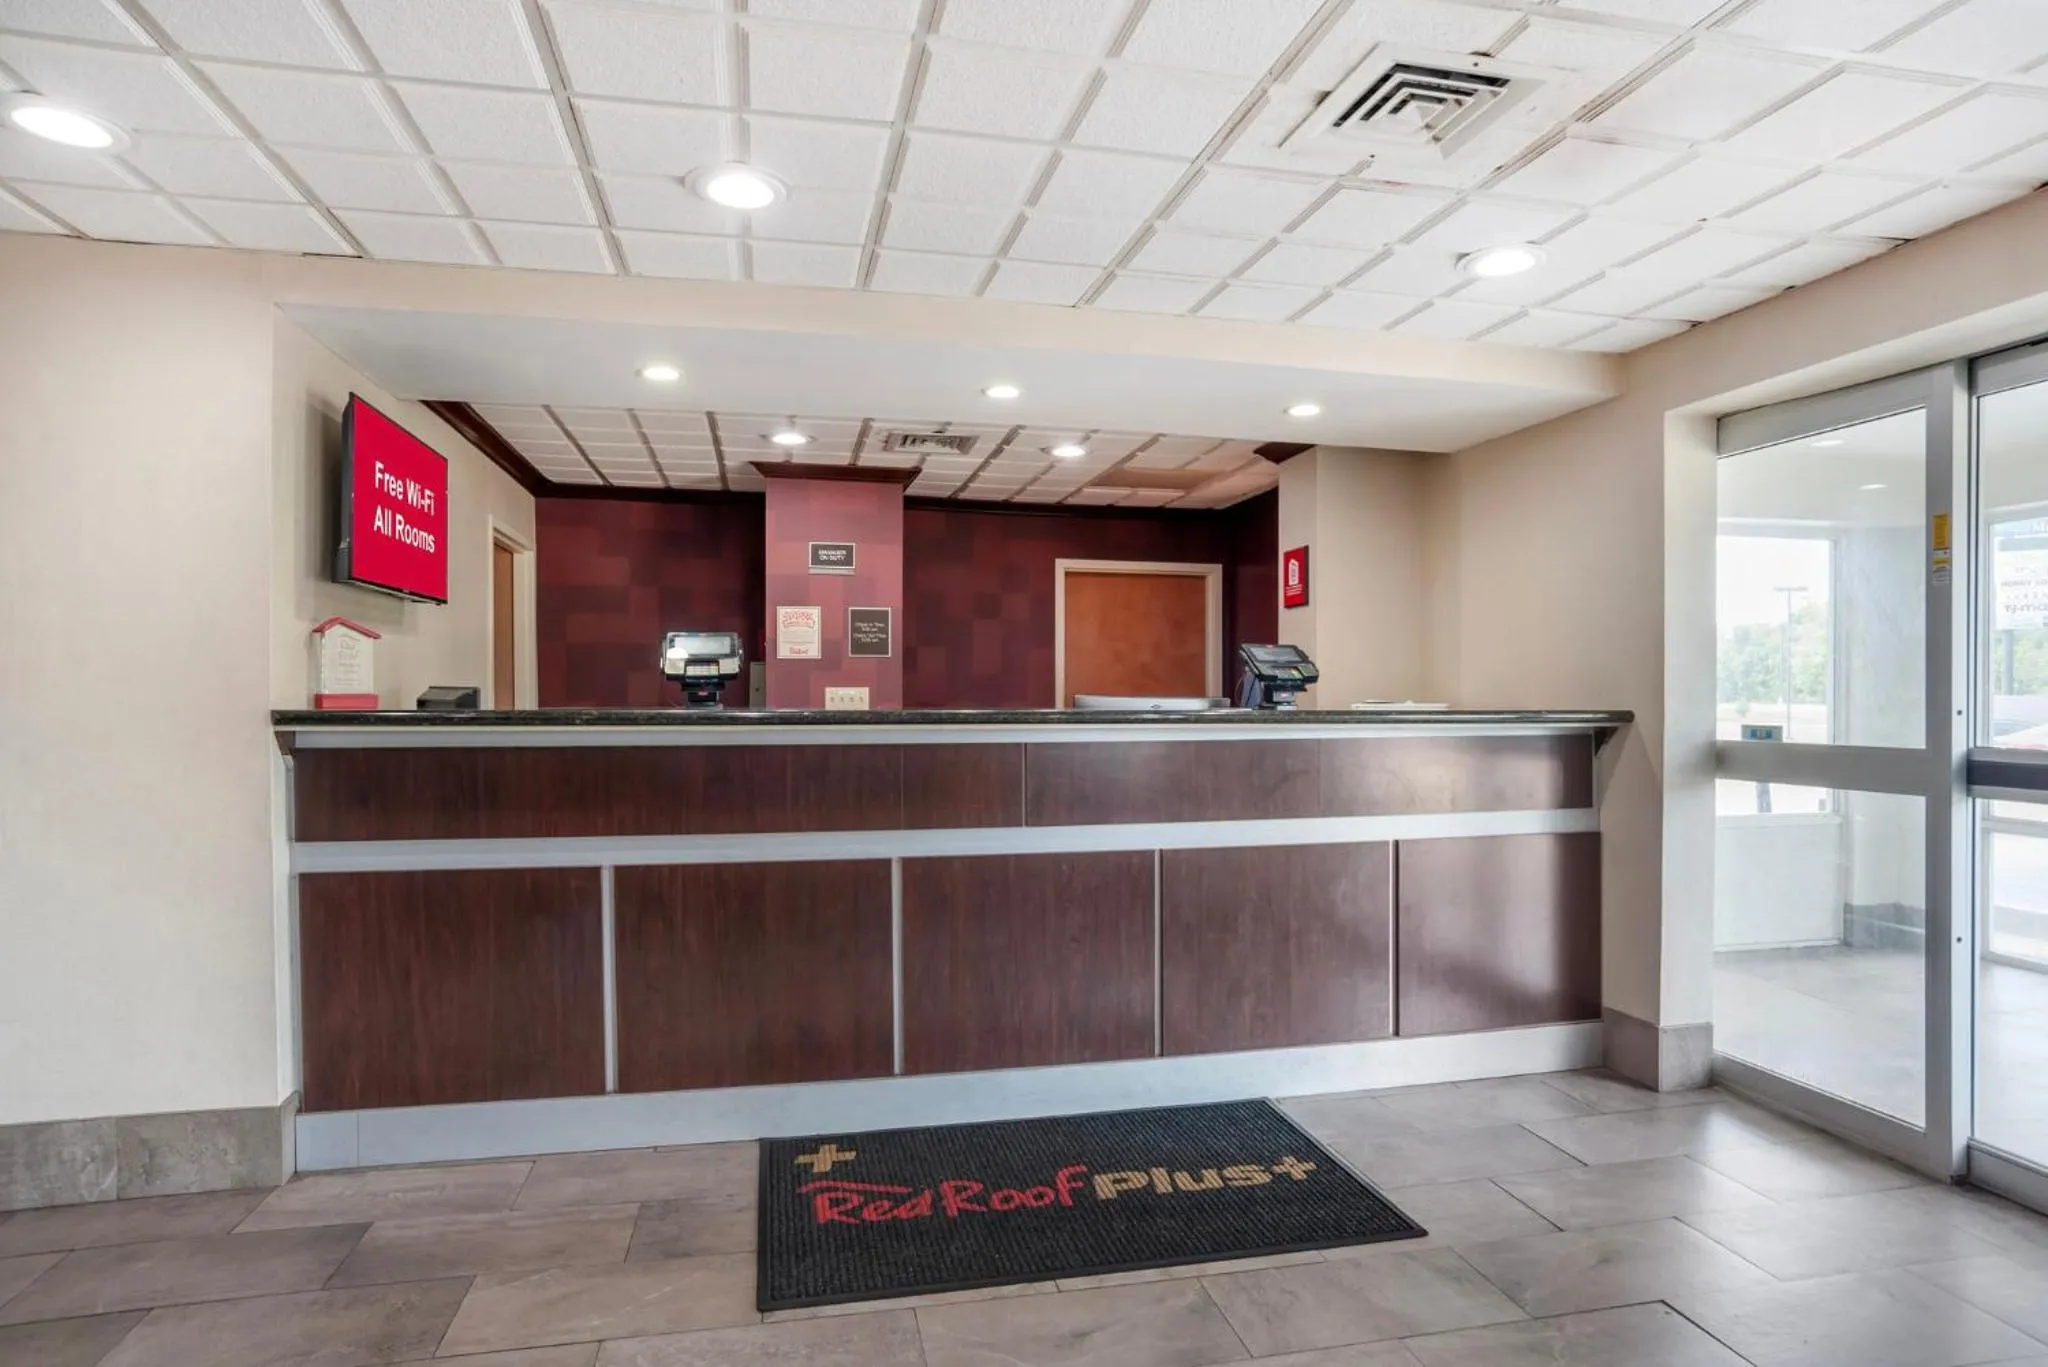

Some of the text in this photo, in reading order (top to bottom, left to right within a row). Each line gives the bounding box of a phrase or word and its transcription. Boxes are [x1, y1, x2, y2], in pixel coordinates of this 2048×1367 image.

[375, 461, 435, 516] Free Wi-Fi
[374, 505, 436, 554] All Rooms
[808, 1186, 934, 1224] Red
[939, 1163, 1088, 1217] Roof
